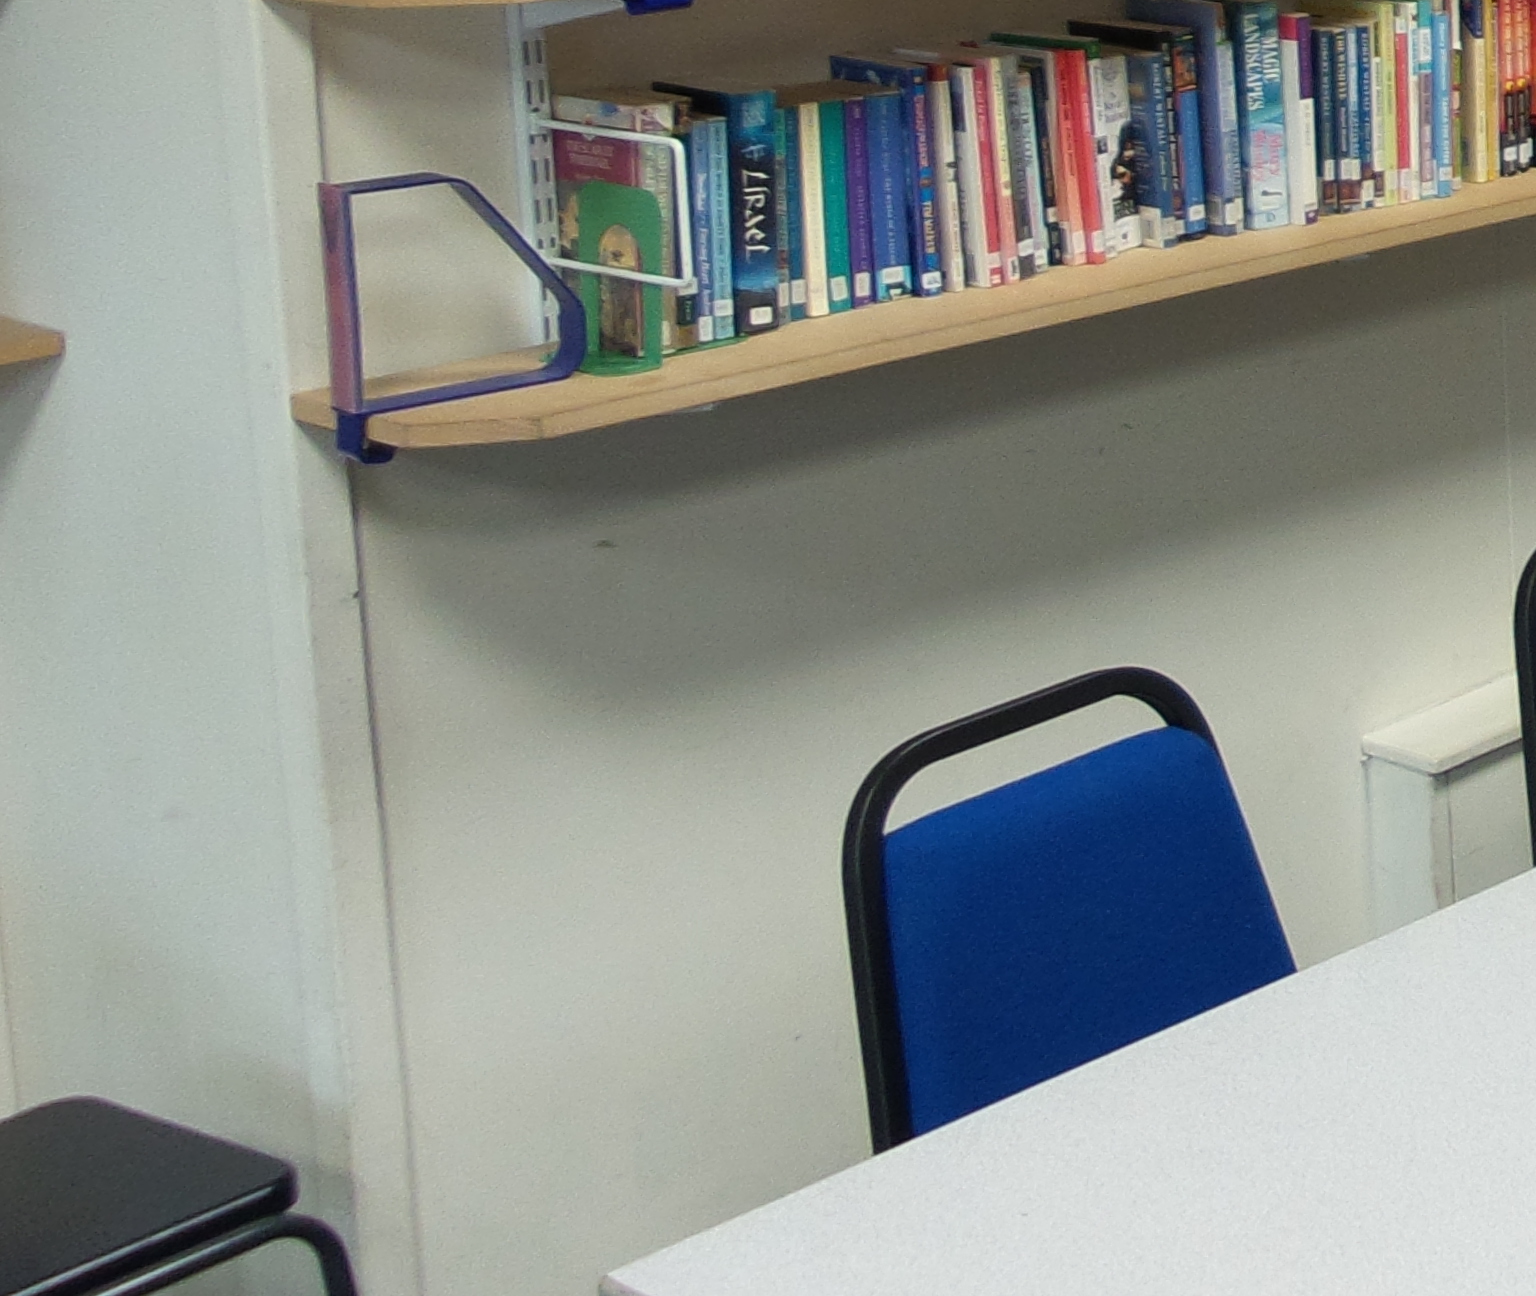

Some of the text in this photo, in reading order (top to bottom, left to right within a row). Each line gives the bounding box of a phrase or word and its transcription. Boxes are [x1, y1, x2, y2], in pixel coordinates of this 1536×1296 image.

[1244, 12, 1267, 112] LANDSCAPES
[1261, 36, 1281, 84] MAGIC
[742, 168, 772, 264] LIRAEL
